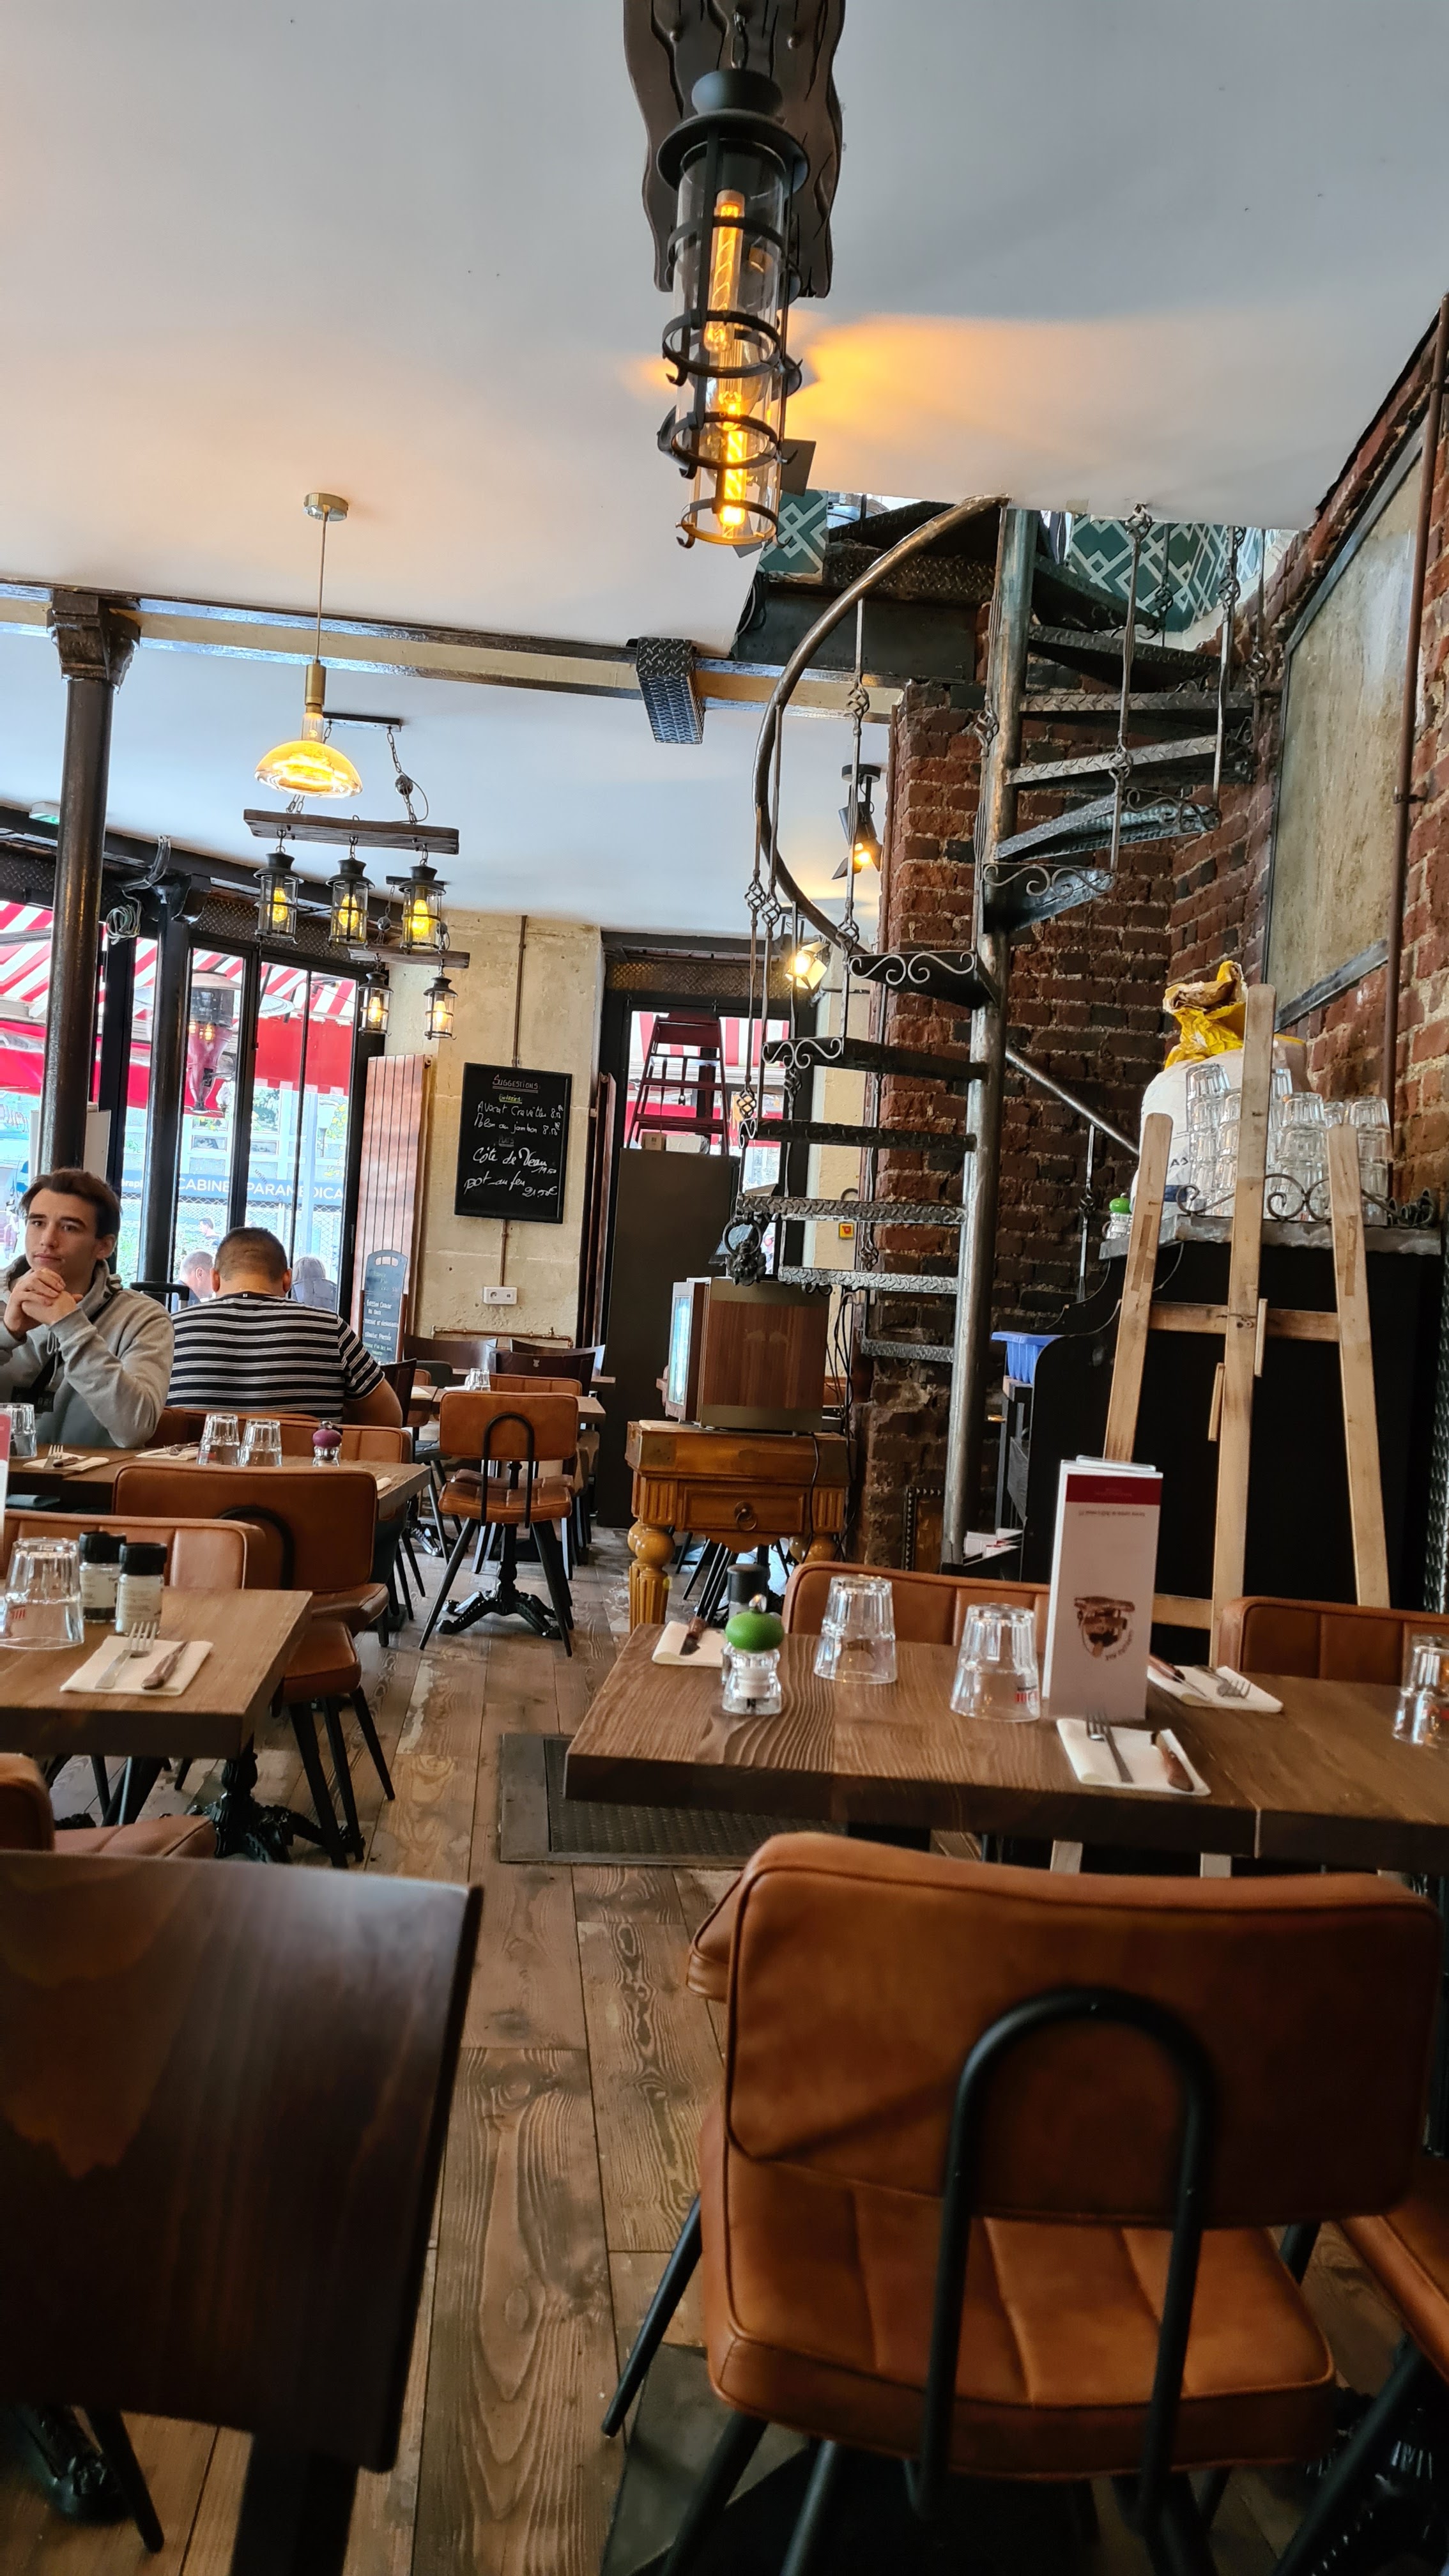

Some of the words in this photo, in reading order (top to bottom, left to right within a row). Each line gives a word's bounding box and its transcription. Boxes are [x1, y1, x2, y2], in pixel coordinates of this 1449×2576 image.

[511, 1121, 537, 1134] jambon
[502, 1150, 517, 1165] de
[518, 1147, 548, 1167] Veau
[178, 1177, 229, 1193] CABINE
[509, 1170, 526, 1191] feu
